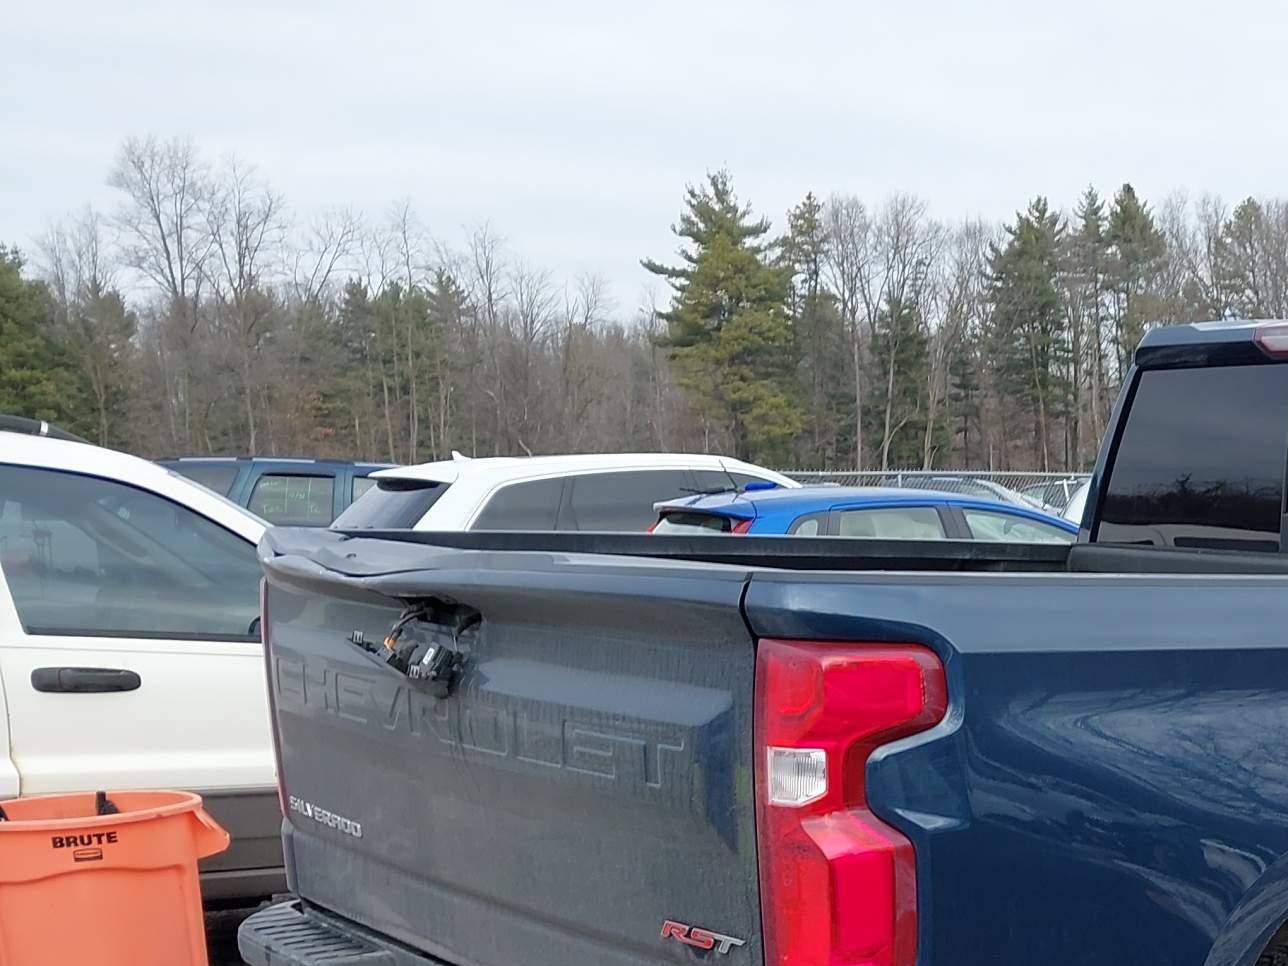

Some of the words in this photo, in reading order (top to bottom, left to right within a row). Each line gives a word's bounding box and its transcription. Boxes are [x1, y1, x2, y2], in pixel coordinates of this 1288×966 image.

[288, 794, 363, 839] SILVERADO
[52, 831, 118, 848] BRUTE
[659, 918, 747, 955] RST
